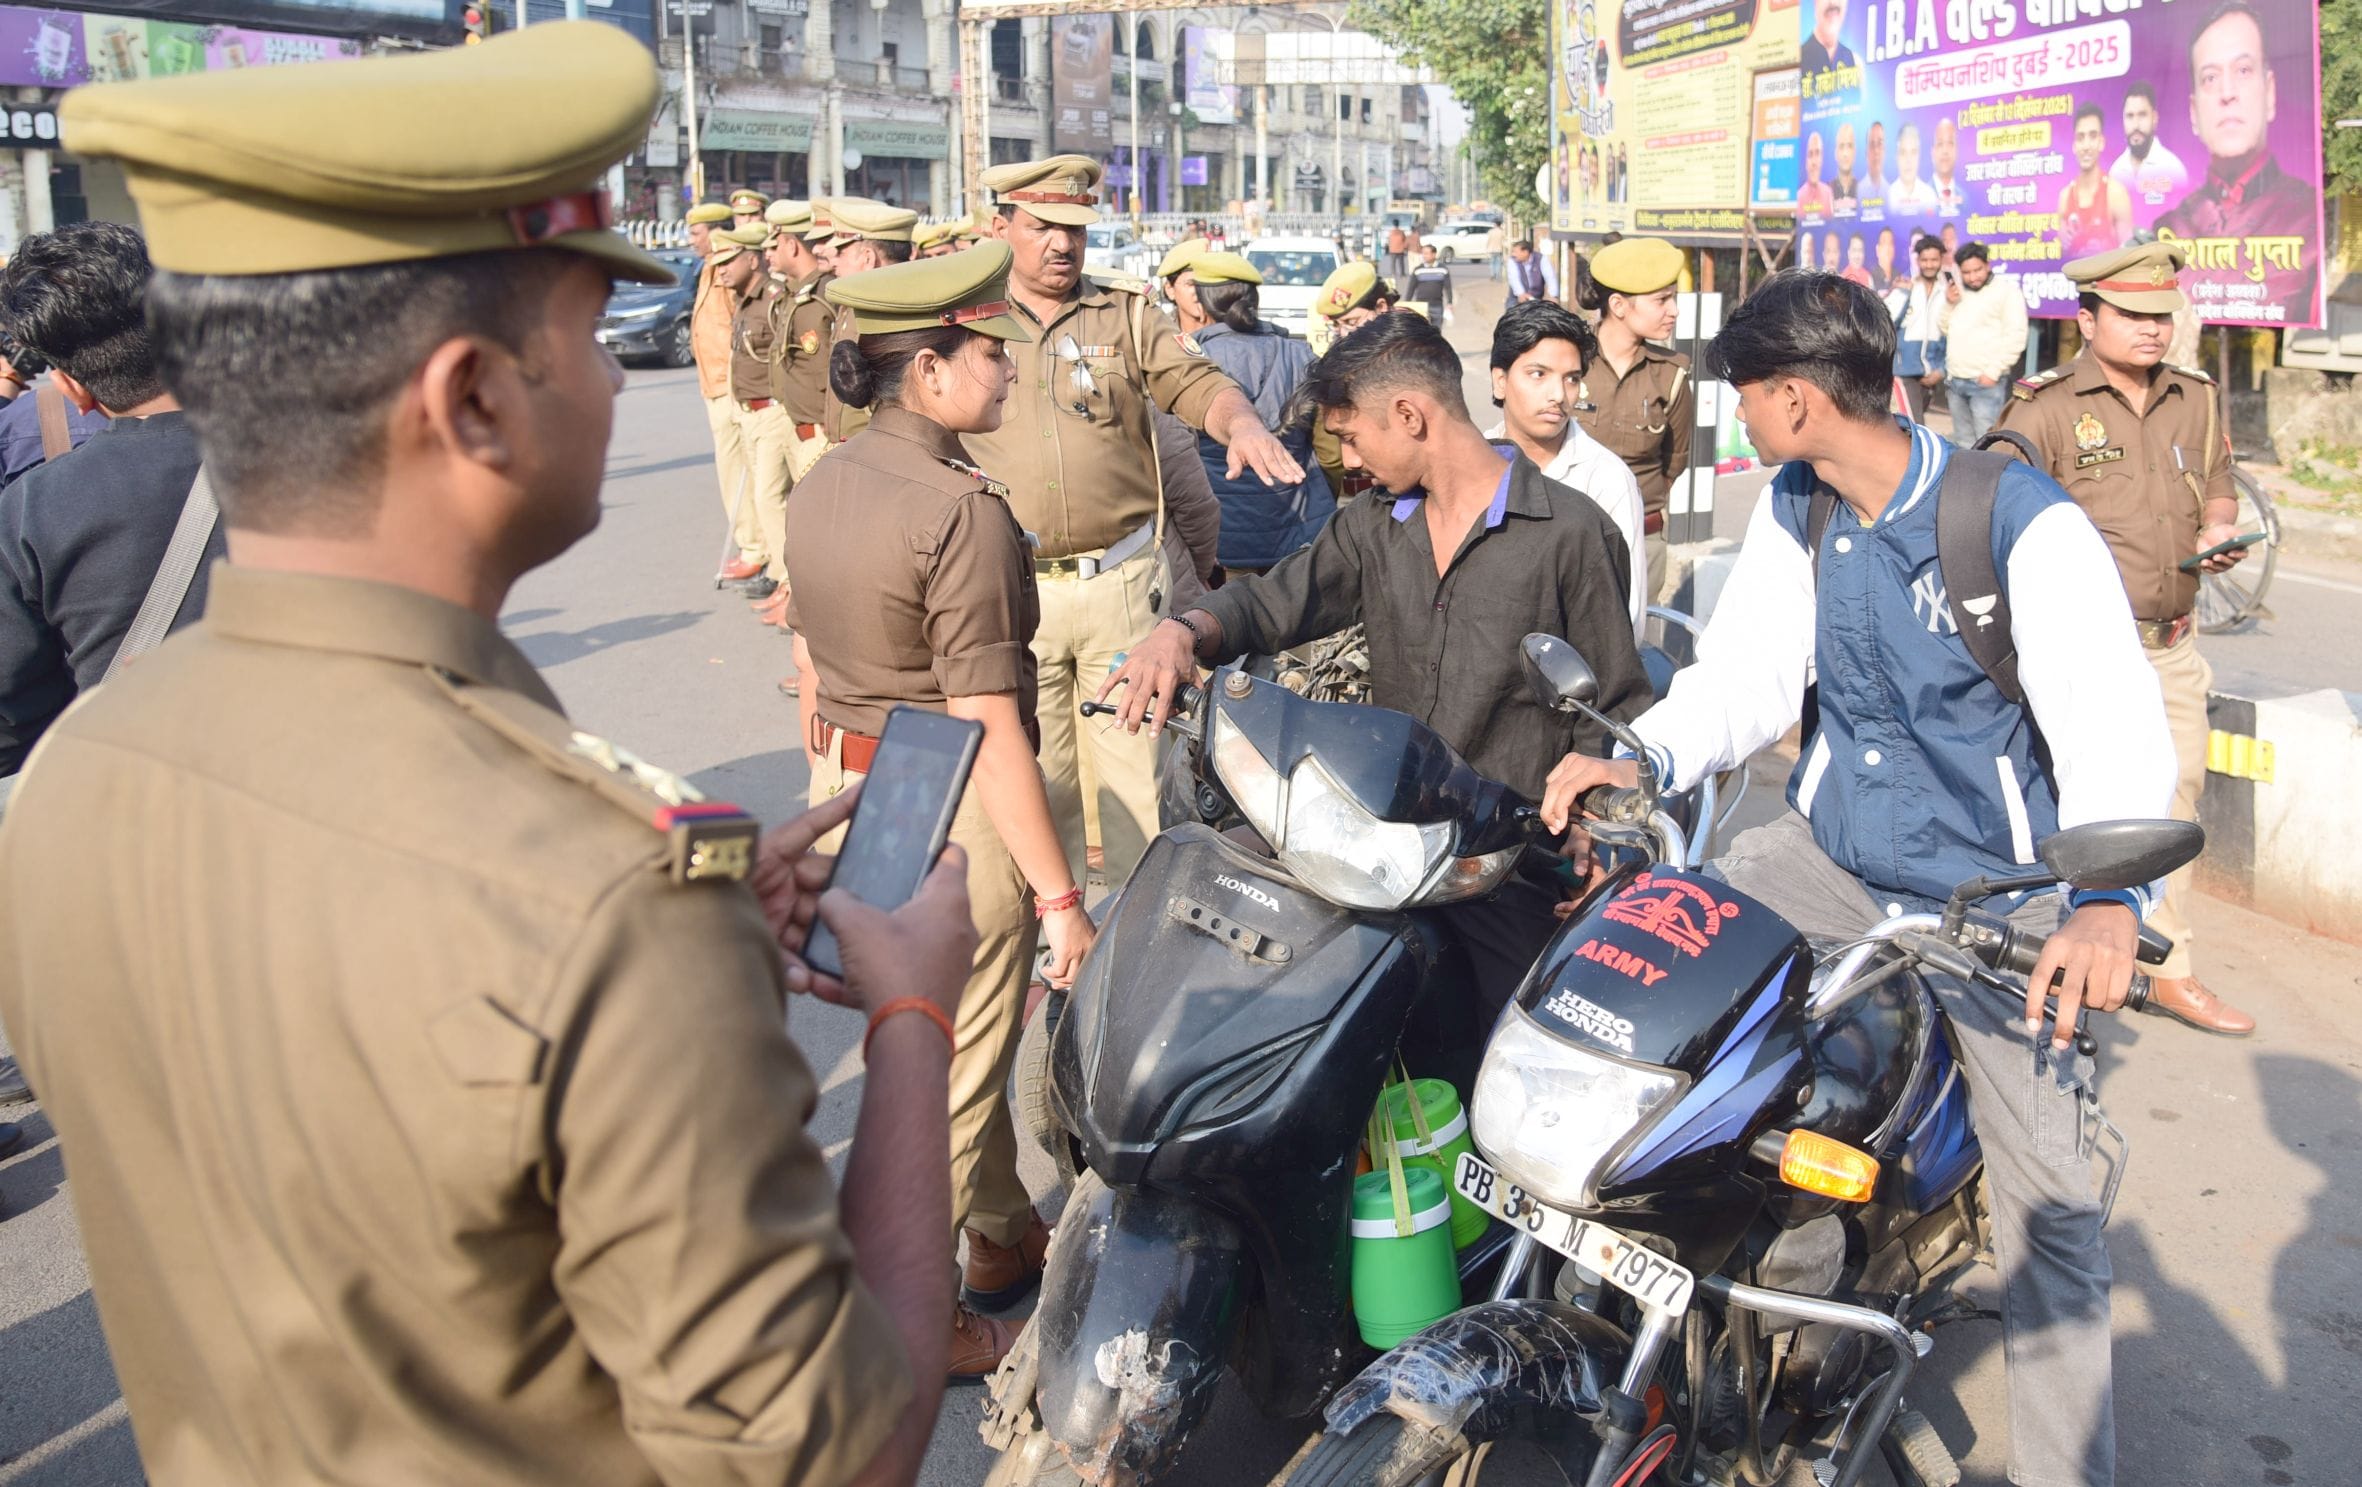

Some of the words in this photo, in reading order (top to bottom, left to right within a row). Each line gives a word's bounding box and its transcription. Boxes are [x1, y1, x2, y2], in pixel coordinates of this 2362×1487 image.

[1866, 0, 1939, 63] I.B.A
[2012, 40, 2049, 87] दुबई
[744, 122, 778, 136] COFFEE
[780, 124, 809, 138] HOUSE
[885, 131, 917, 145] COFFEE
[919, 133, 947, 147] HOUSE
[2244, 236, 2305, 282] गुप्ता
[1213, 873, 1281, 913] HONDA
[1574, 938, 1669, 987] ARMY
[1544, 996, 1634, 1054] HONDA
[1557, 987, 1635, 1036] HERO
[1459, 1156, 1495, 1205] PB
[1559, 1214, 1590, 1258] M
[1611, 1239, 1689, 1307] 7977
